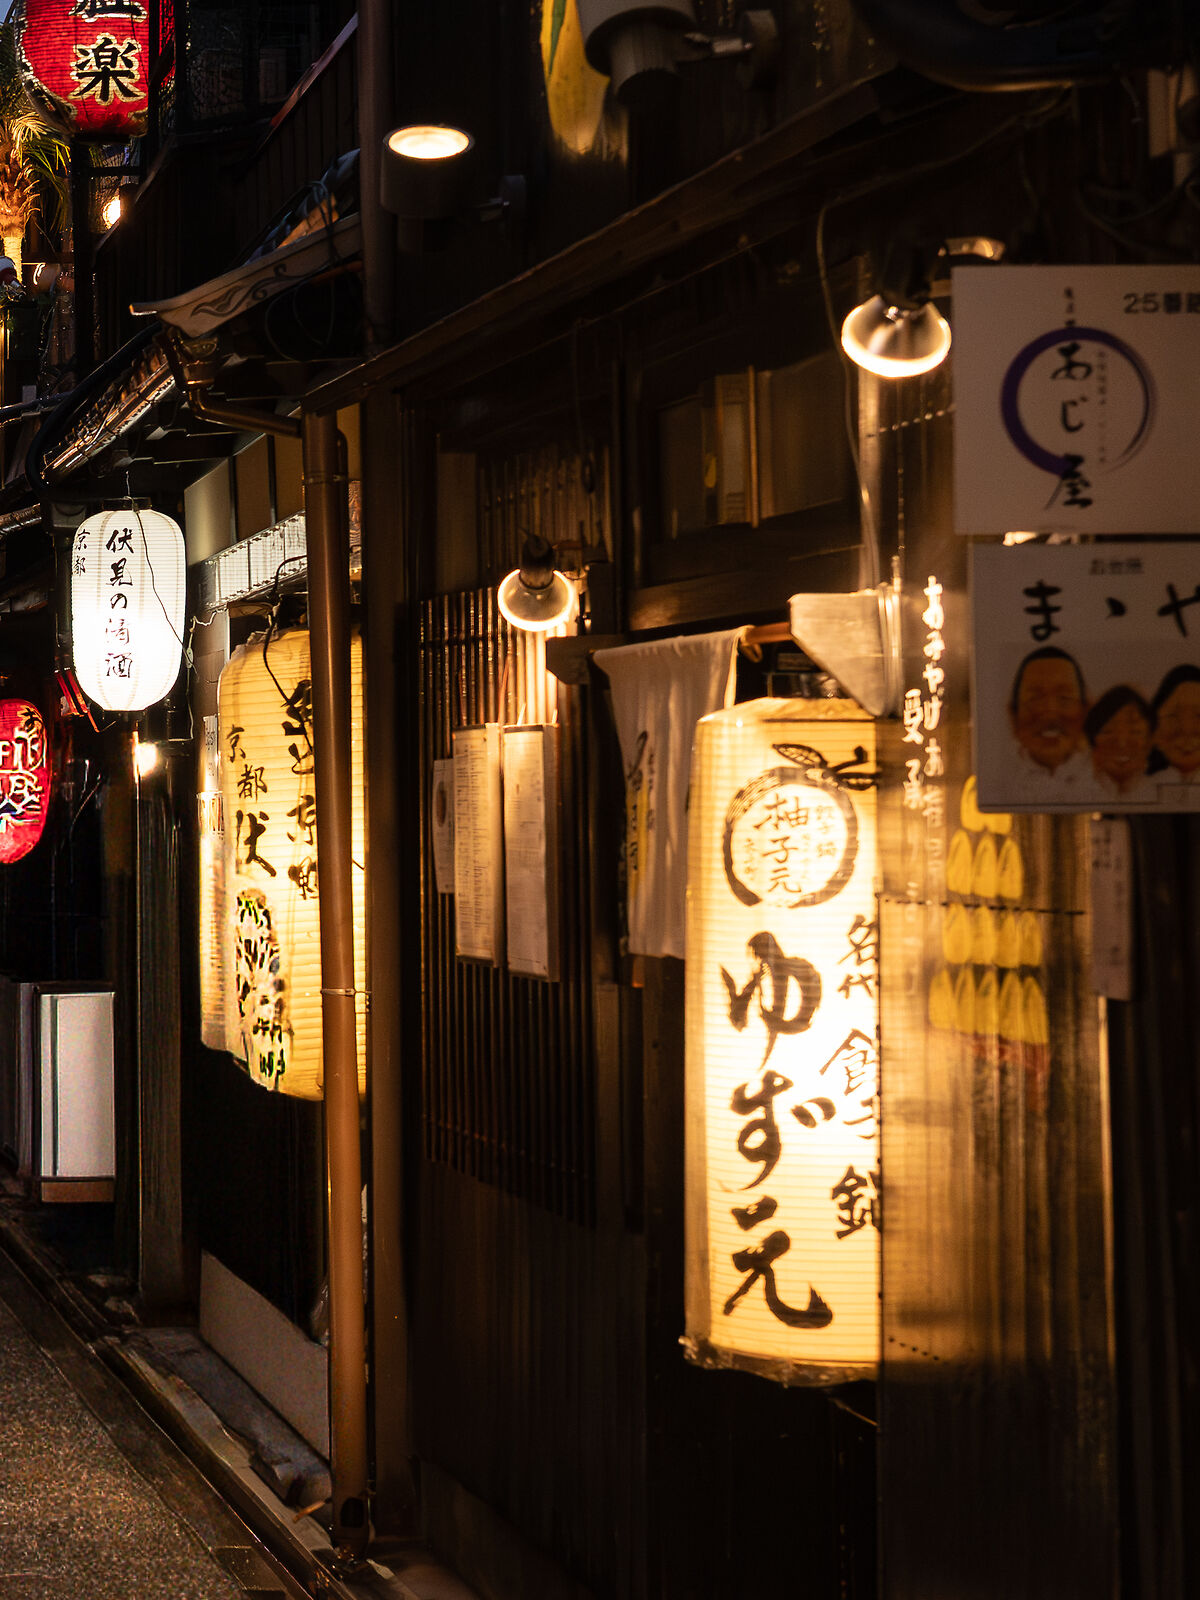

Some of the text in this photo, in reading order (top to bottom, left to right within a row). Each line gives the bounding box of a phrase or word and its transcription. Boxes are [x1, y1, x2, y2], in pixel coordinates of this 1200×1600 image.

[72, 529, 91, 577] 京都
[720, 930, 835, 1329] ゆず元
